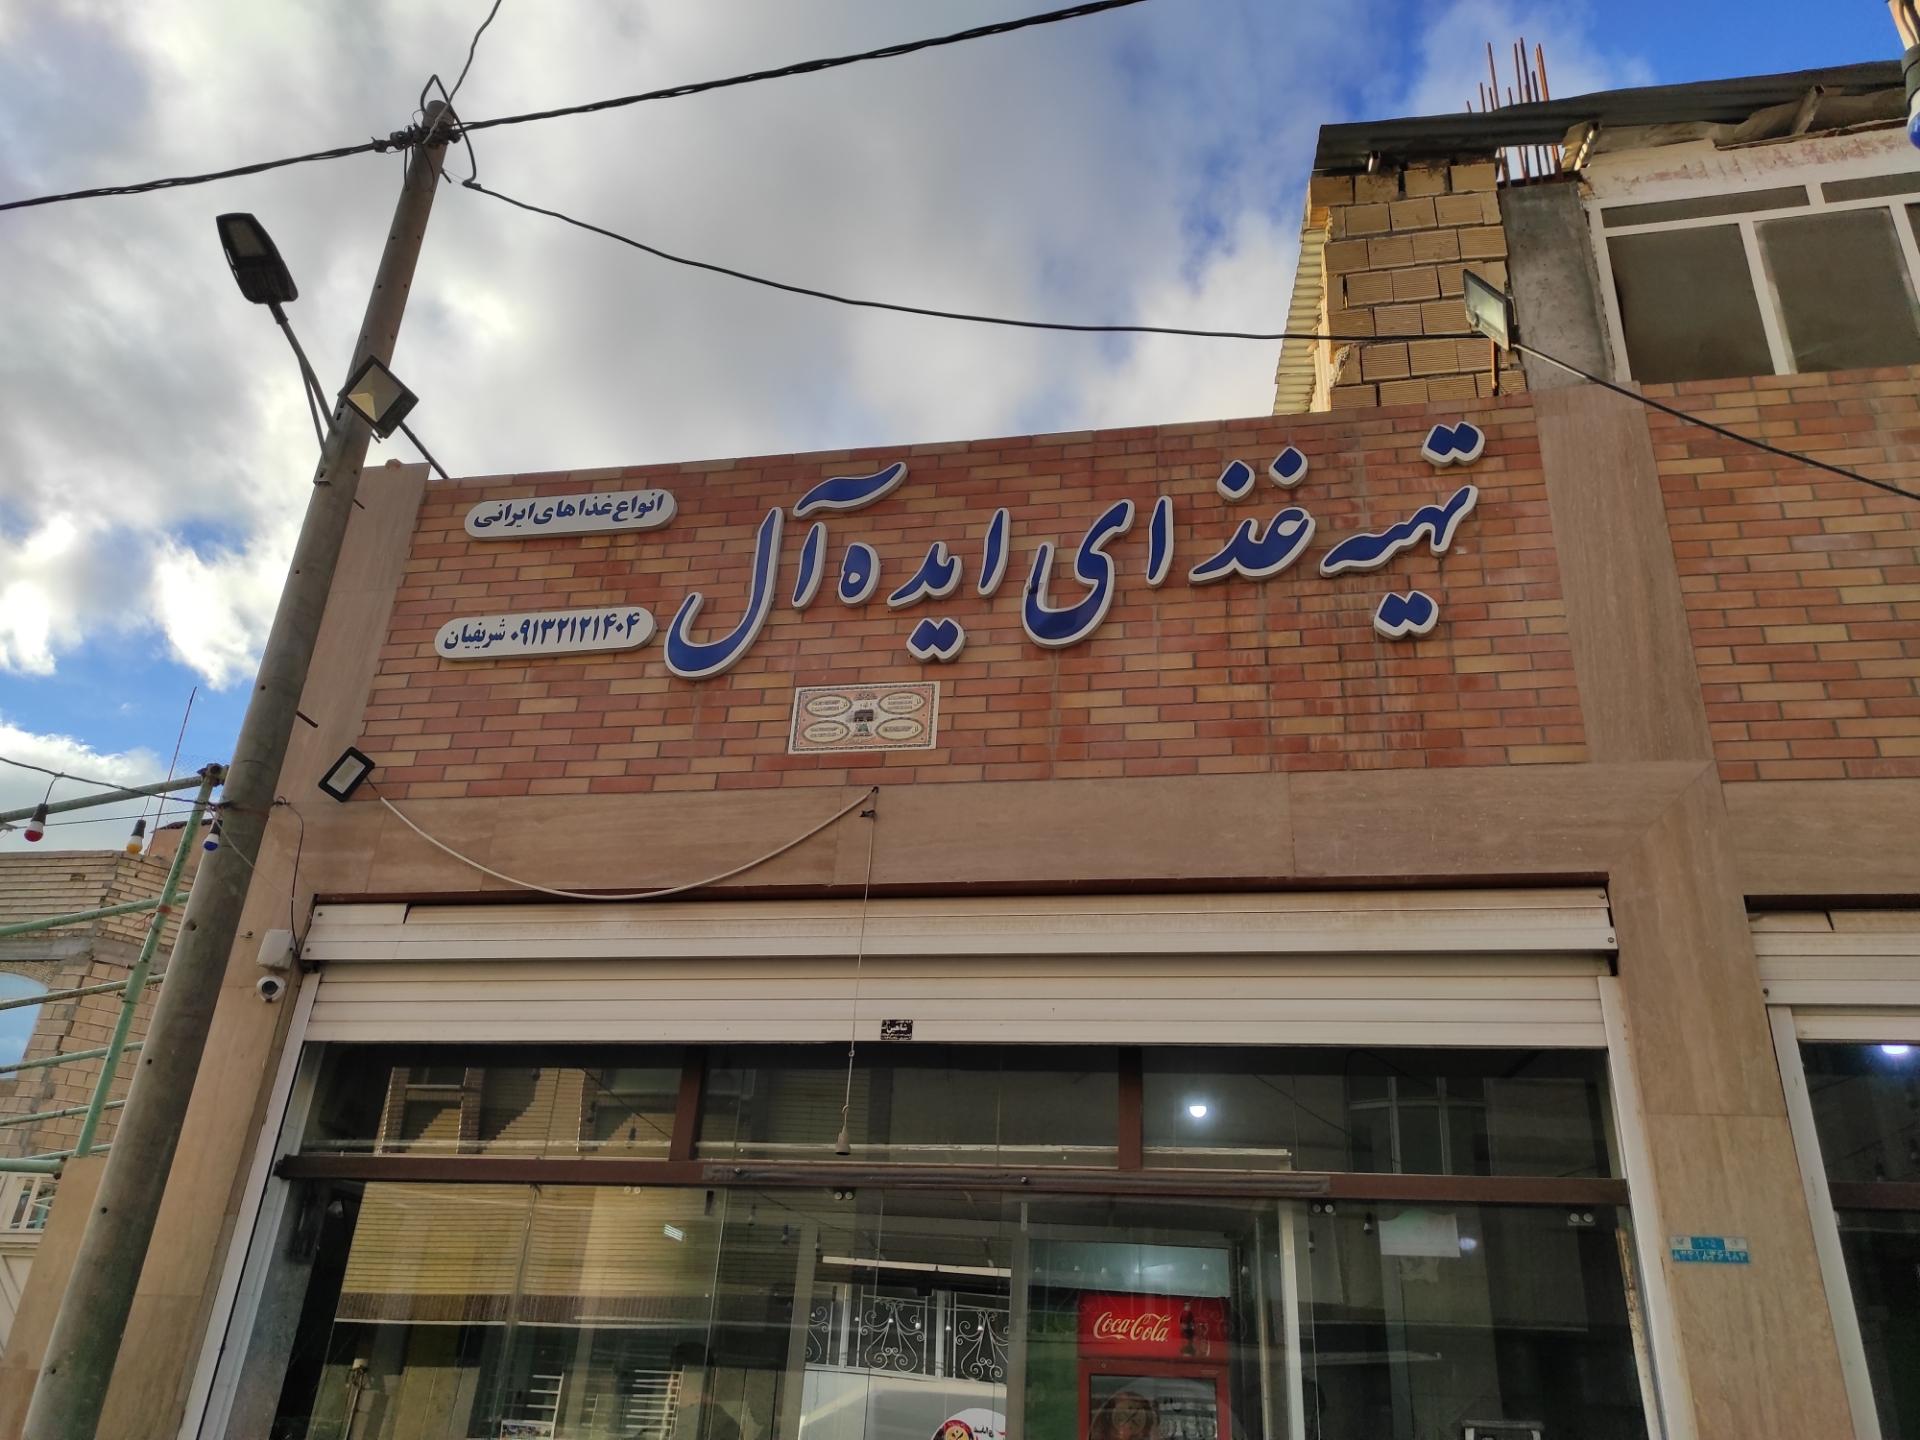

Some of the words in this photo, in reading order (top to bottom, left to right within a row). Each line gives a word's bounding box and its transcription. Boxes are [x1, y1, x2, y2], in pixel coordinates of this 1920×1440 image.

[474, 502, 536, 528] ایرانی
[612, 492, 665, 522] انواع
[1022, 446, 1316, 648] غذای
[1320, 421, 1486, 640] تهیه
[664, 461, 908, 679] آل
[838, 507, 1011, 662] ایده
[444, 617, 506, 650] شریفیان
[510, 612, 640, 646] ۰۹۱۳۲۱۲۱۴۰۴
[1093, 1311, 1172, 1342] Coca-Cola
